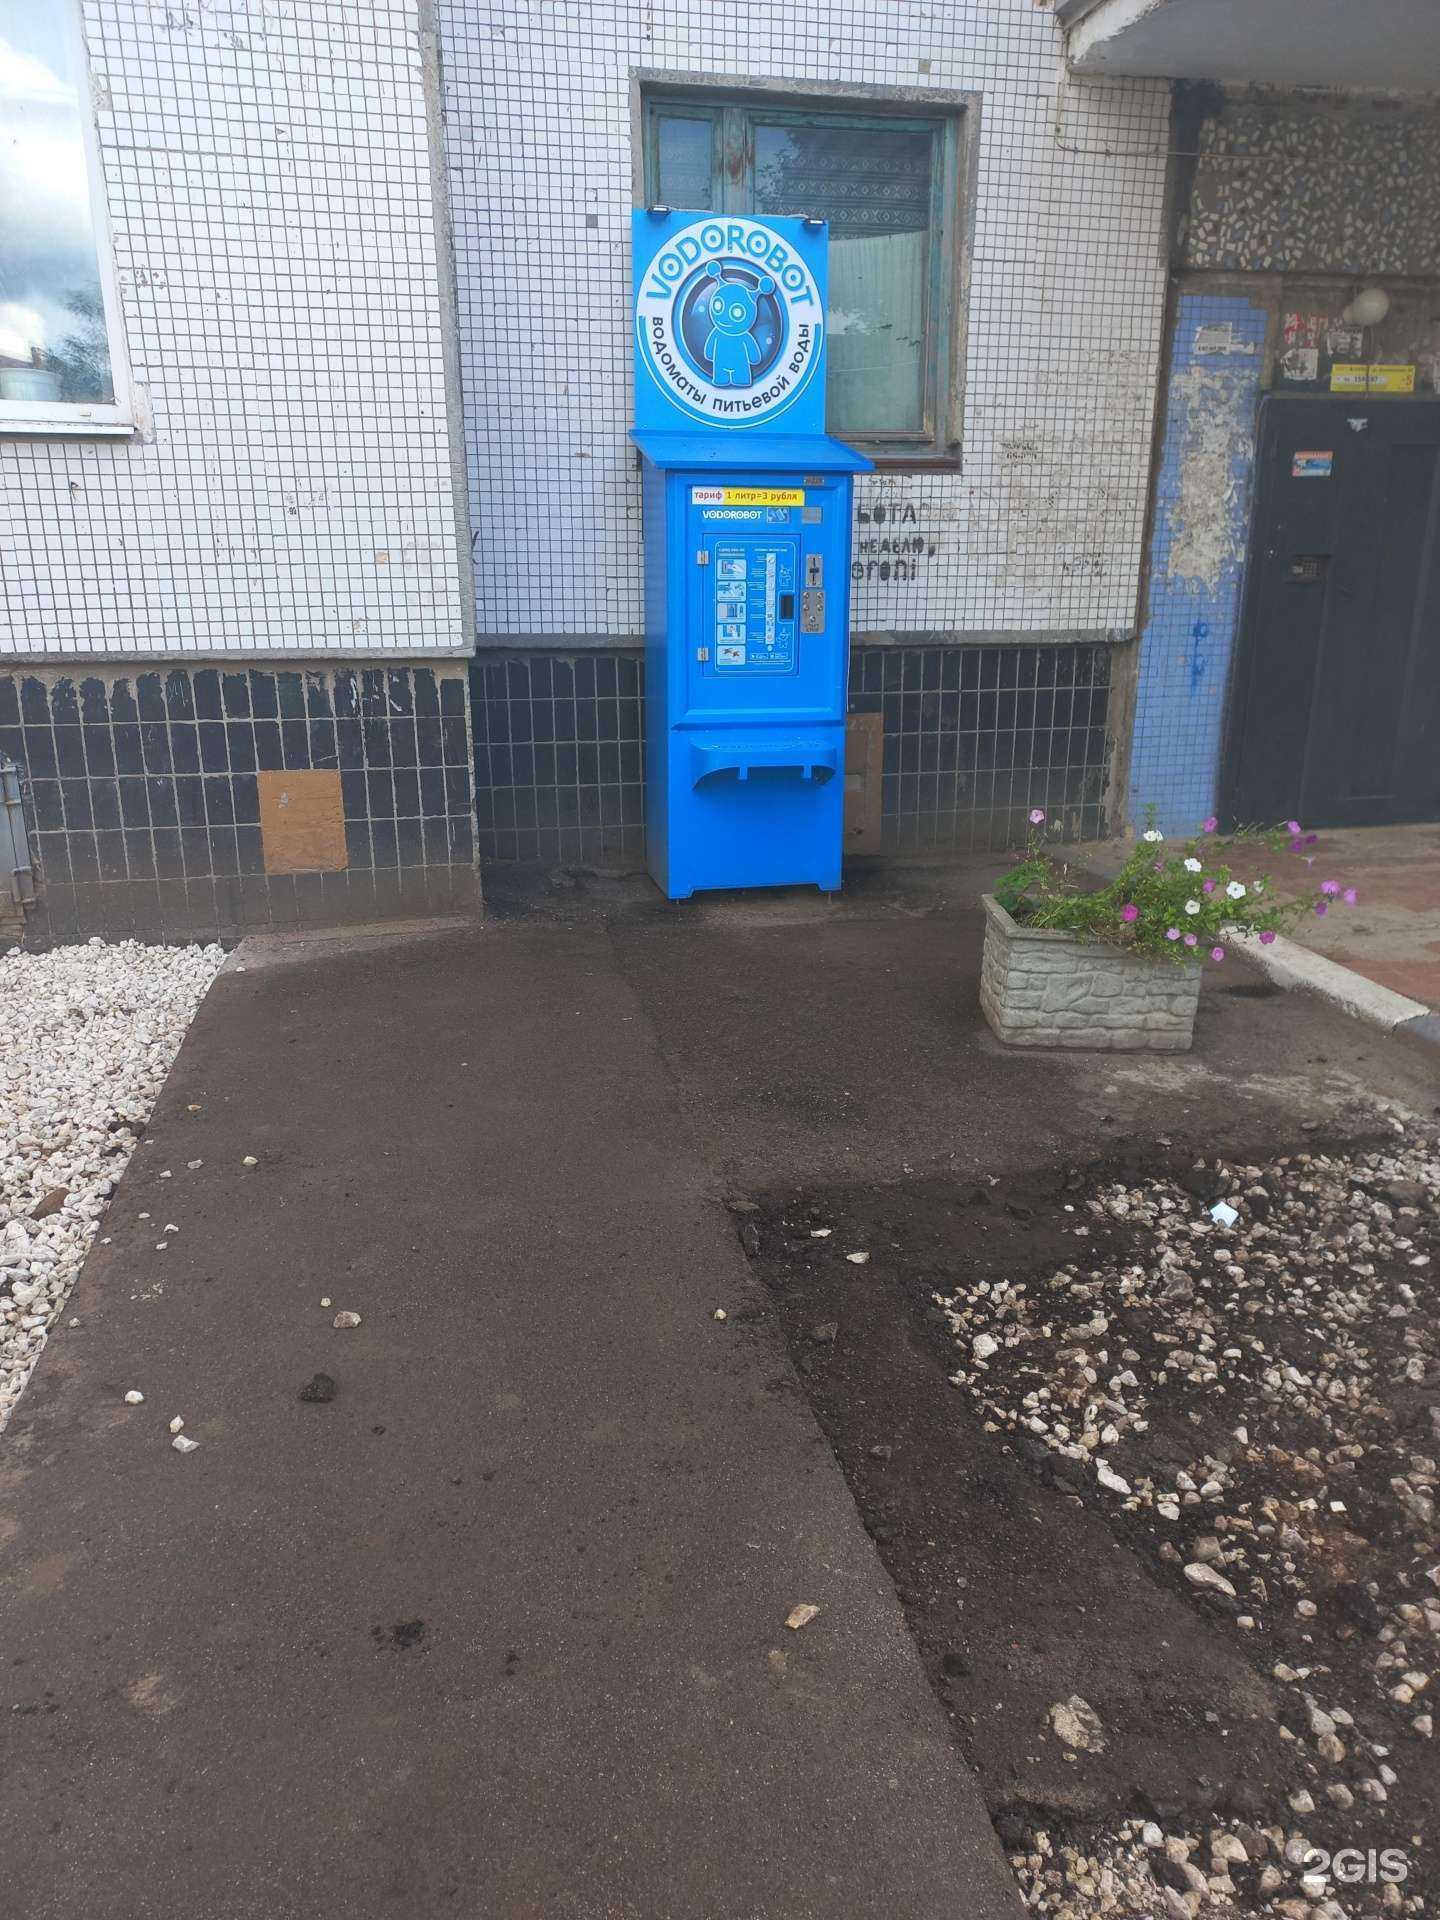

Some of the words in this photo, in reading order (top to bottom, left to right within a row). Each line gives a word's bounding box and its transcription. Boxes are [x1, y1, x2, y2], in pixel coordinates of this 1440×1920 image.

[646, 224, 814, 307] VODOROBOT
[694, 491, 723, 501] тариф
[727, 491, 732, 499] 1
[771, 491, 798, 501] рубля
[702, 510, 763, 519] VODOROBOT
